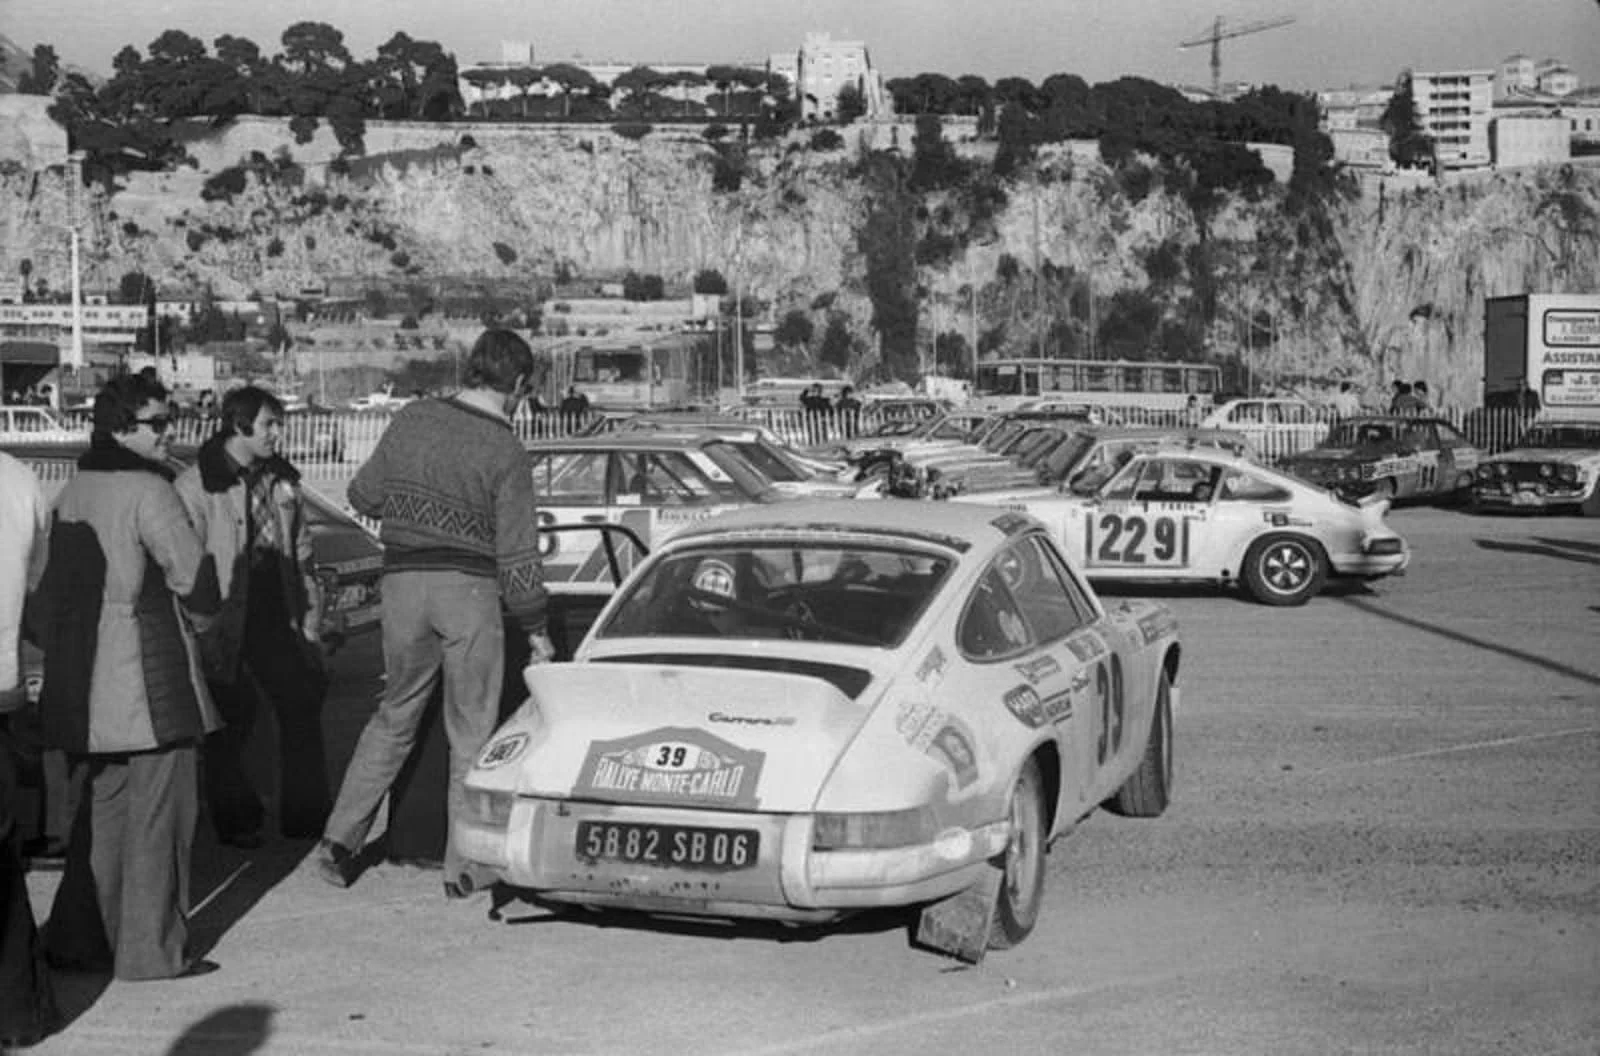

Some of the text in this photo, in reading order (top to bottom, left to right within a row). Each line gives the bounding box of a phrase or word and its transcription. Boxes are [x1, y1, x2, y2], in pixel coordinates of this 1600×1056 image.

[1099, 513, 1176, 563] 229
[708, 712, 772, 725] Carrera
[656, 745, 687, 767] 39
[591, 757, 745, 798] RALLYE MONTE-CARLO
[585, 826, 660, 861] 5882
